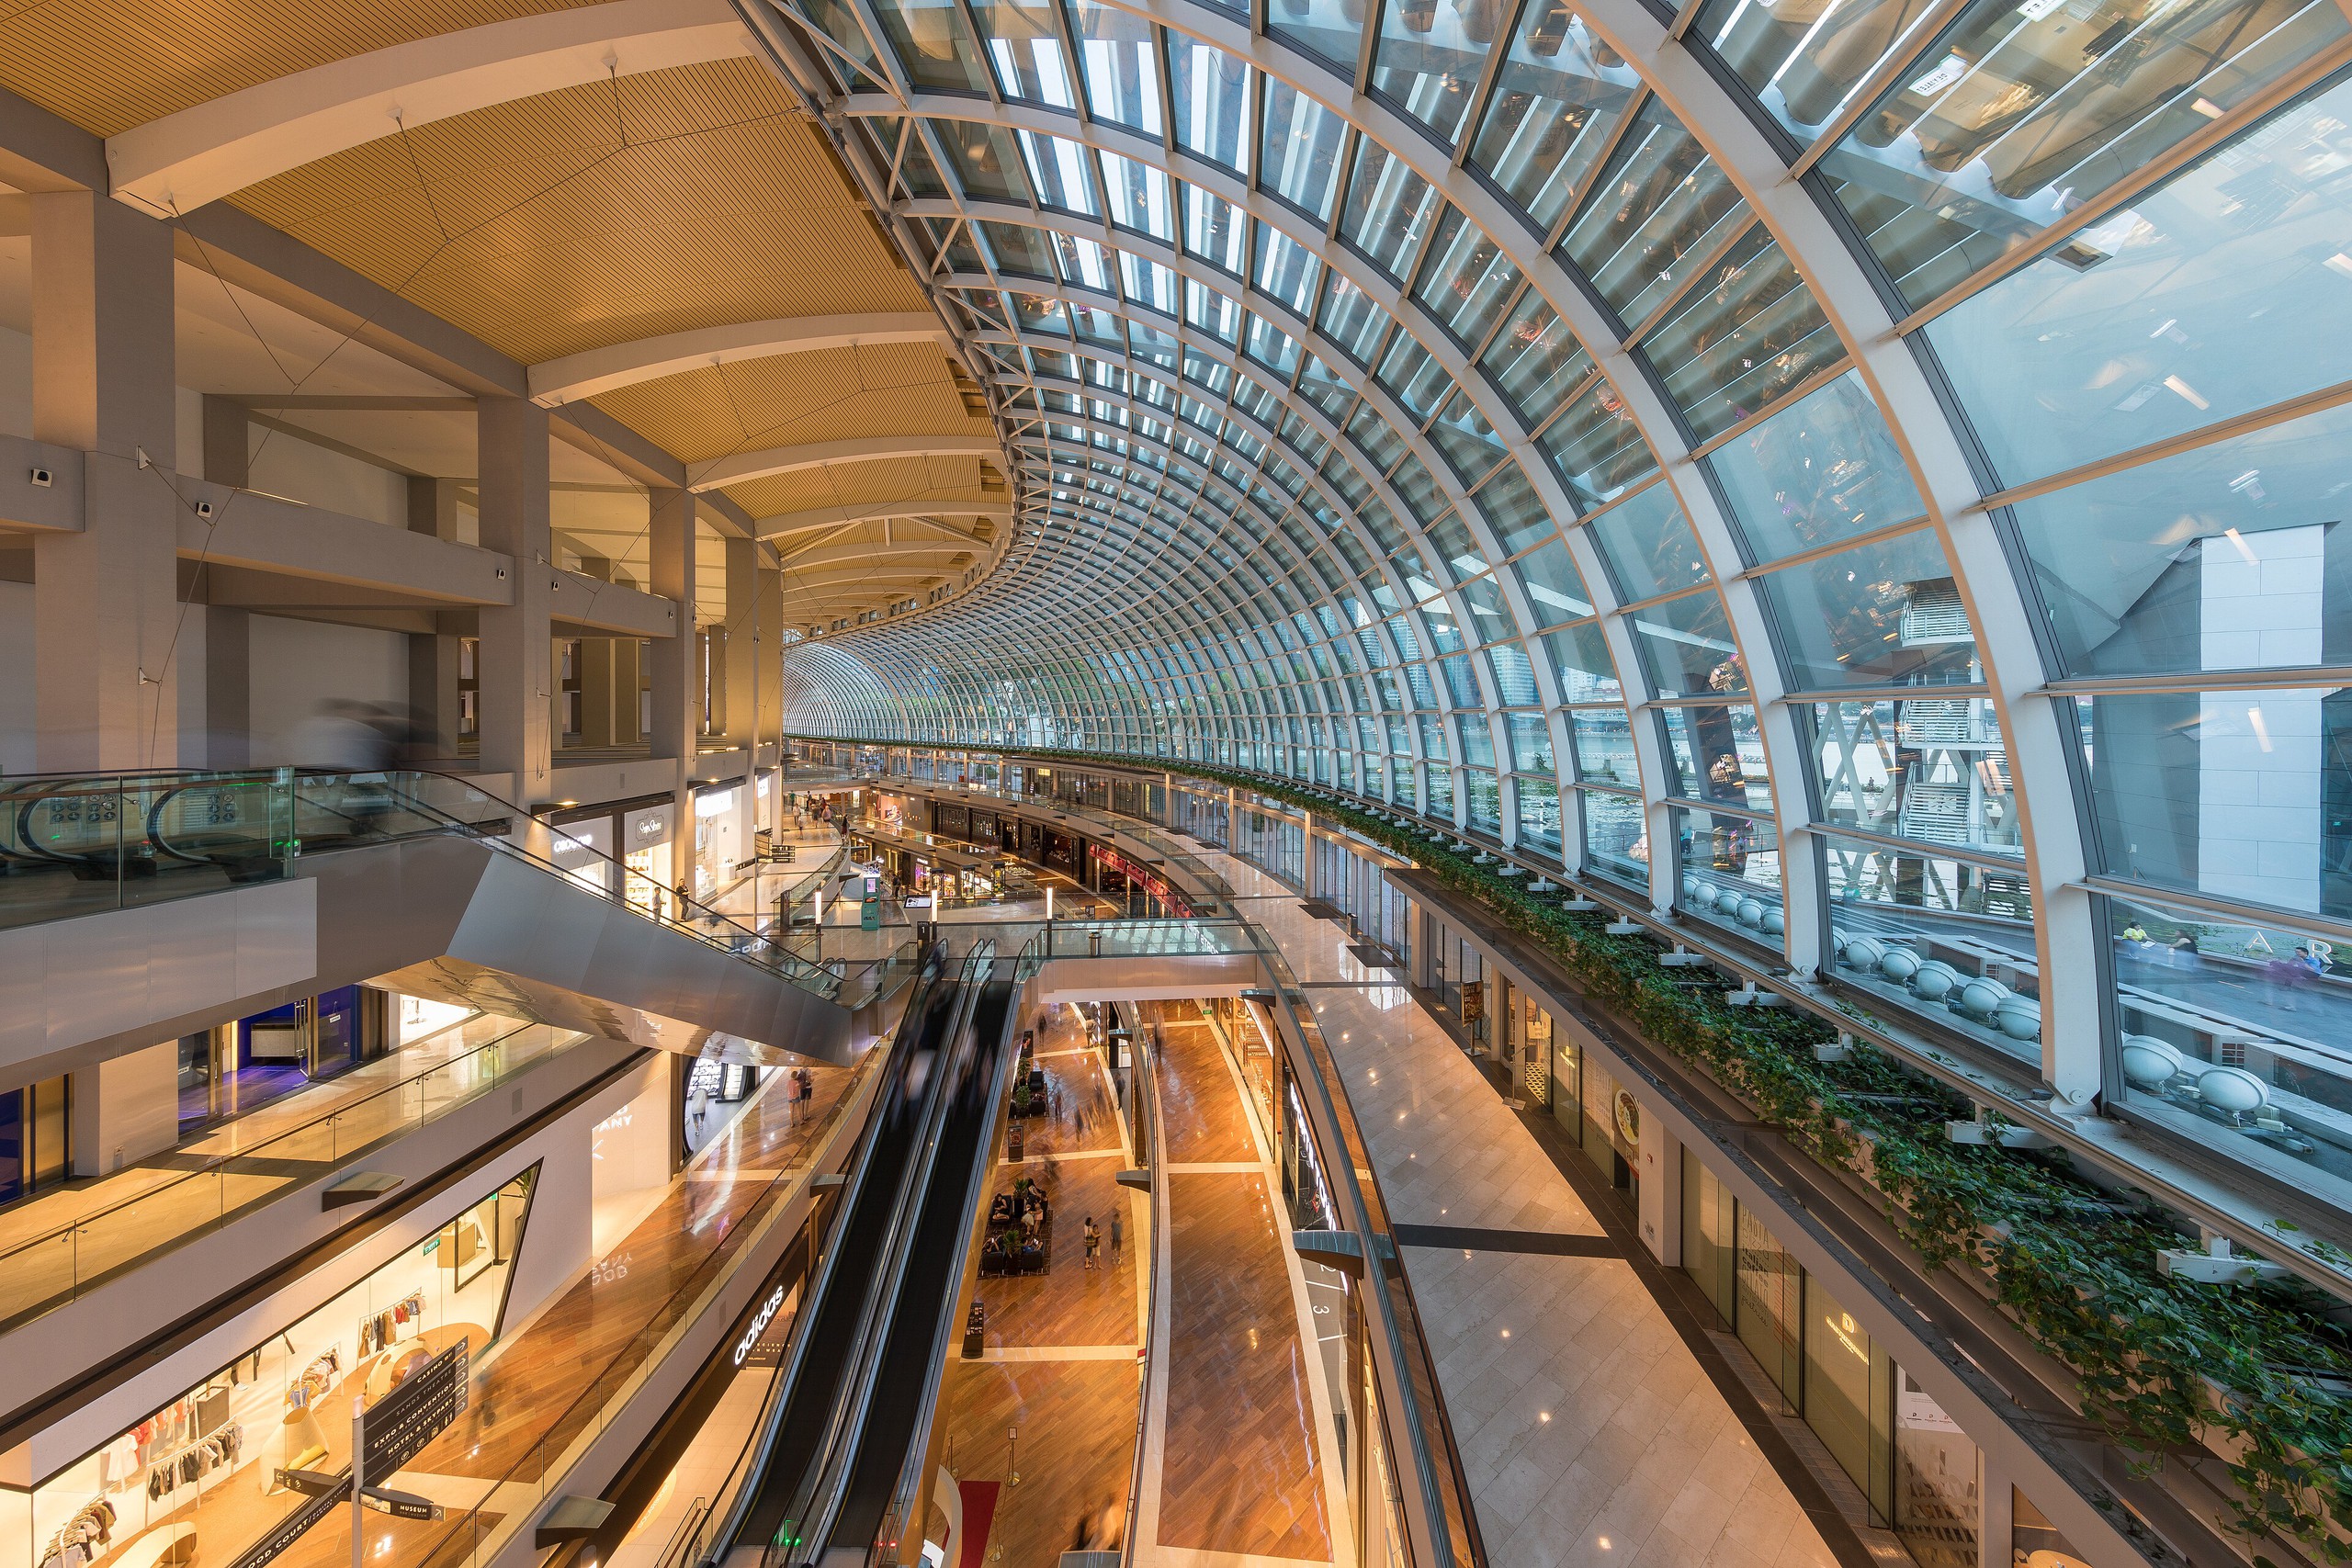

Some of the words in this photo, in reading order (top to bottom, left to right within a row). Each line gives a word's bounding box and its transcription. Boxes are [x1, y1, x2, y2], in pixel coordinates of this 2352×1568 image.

[921, 926, 925, 934] 1
[1742, 1256, 1769, 1288] coffee
[1313, 1305, 1329, 1314] 3
[735, 1285, 783, 1365] adidas
[417, 1360, 443, 1383] CASINO
[396, 1395, 420, 1416] SANDS
[423, 1369, 452, 1394] THEATRE
[374, 1428, 397, 1449] EXPO
[406, 1382, 454, 1424] CONVENTION
[388, 1431, 414, 1454] HOTEL
[423, 1397, 454, 1427] SKYPARK
[400, 1505, 427, 1513] MUSEUM
[248, 1549, 272, 1568] OOD
